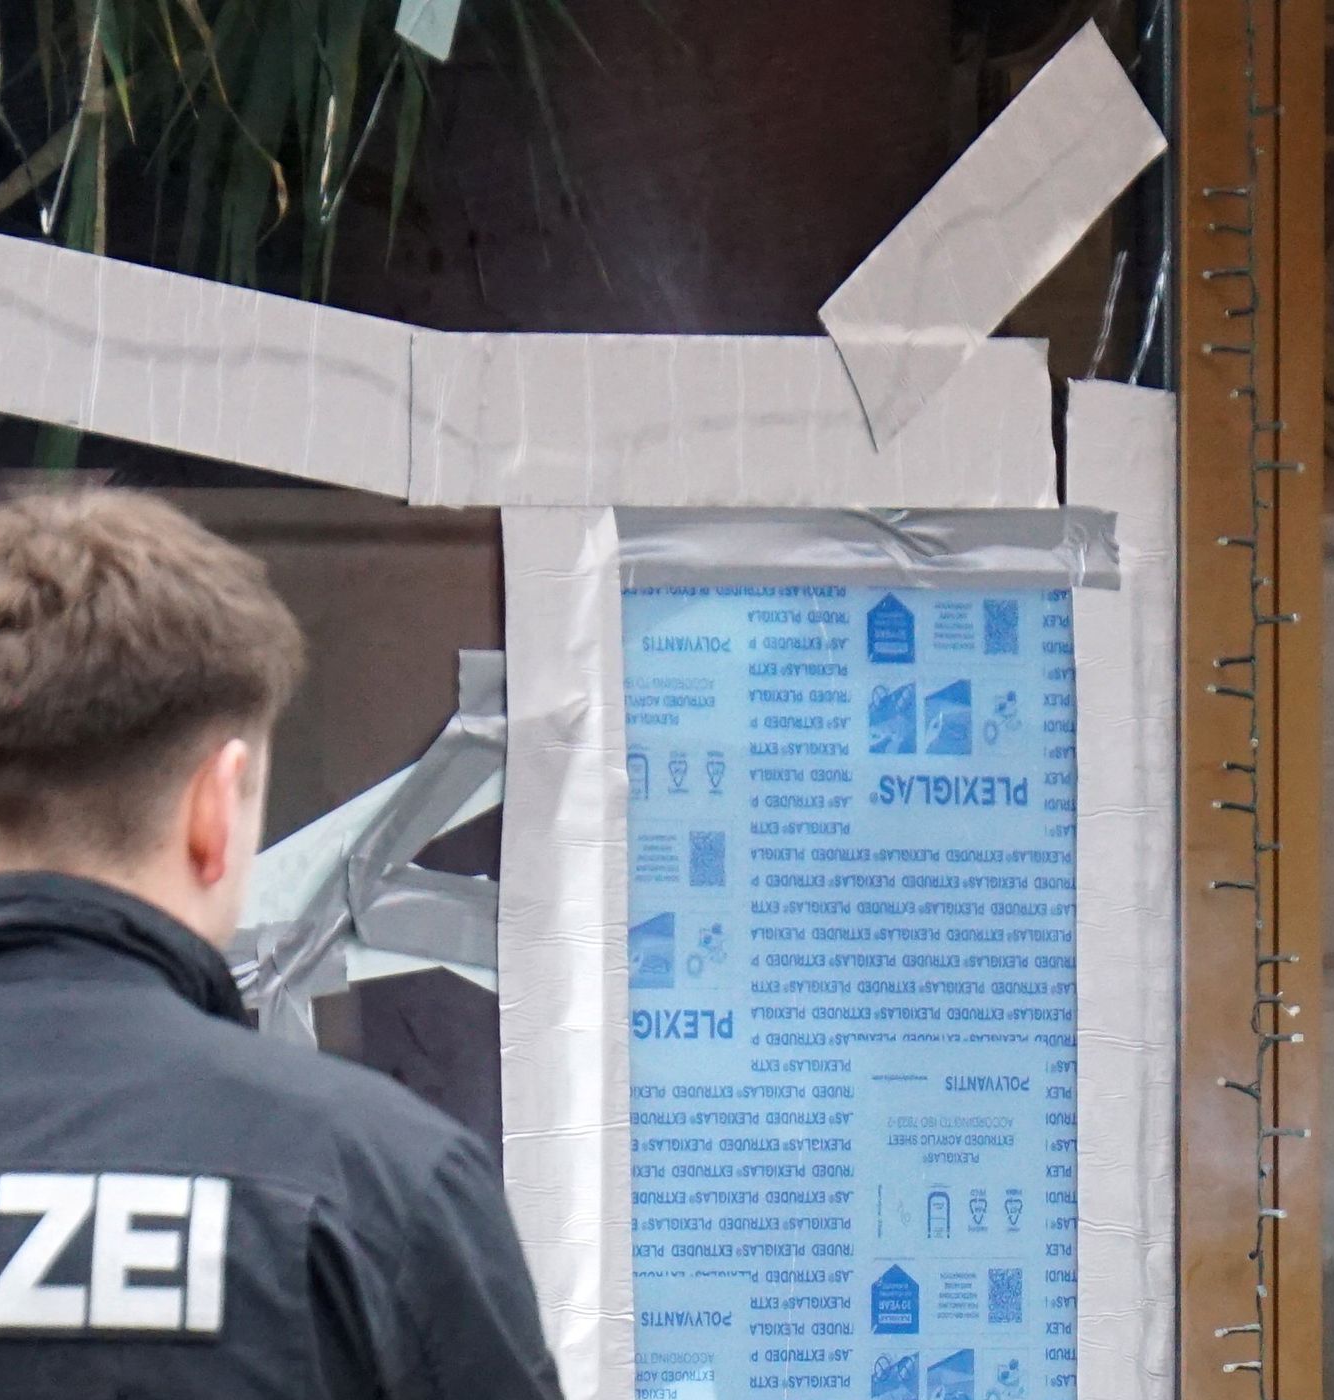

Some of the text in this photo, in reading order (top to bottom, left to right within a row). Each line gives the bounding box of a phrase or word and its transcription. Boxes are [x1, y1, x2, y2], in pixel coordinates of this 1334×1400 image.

[642, 636, 731, 653] POLYVANTIS
[811, 849, 871, 861] EXTRUDED
[946, 850, 1003, 863] EXTRUDED
[765, 875, 825, 887] EXTRUDED
[901, 876, 960, 888] EXTRUDED
[857, 902, 915, 915] EXTRUDED
[991, 903, 1047, 916] EXTRUDED
[812, 928, 871, 941] EXTRUDED
[946, 929, 1004, 942] EXTRUDED
[766, 954, 825, 967] EXTRUDED
[902, 955, 960, 968] EXTRUDED
[858, 981, 916, 994] EXTRUDED
[991, 982, 1047, 994] EXTRUDED
[811, 1008, 871, 1020] EXTRUDED
[947, 1008, 1004, 1021] EXTRUDED
[766, 1033, 826, 1046] EXTRUDED
[945, 1075, 1030, 1091] POLYVANTIS
[672, 1086, 733, 1098] EXTRUDED
[766, 1112, 825, 1124] EXTRUDED
[719, 1139, 779, 1151] EXTRUDED
[887, 1135, 1014, 1145] EXTRUDED ACRYLIC SHEET
[672, 1165, 733, 1178] EXTRUDED
[766, 1191, 825, 1204] EXTRUDED
[719, 1218, 779, 1230] EXTRUDED
[671, 1245, 733, 1257] EXTRUDED
[766, 1271, 825, 1283] EXTRUDED
[641, 1310, 732, 1326] POLYVANTIS
[765, 1350, 824, 1362] EXTRUDED
[661, 1371, 714, 1381] EXTRUDED
